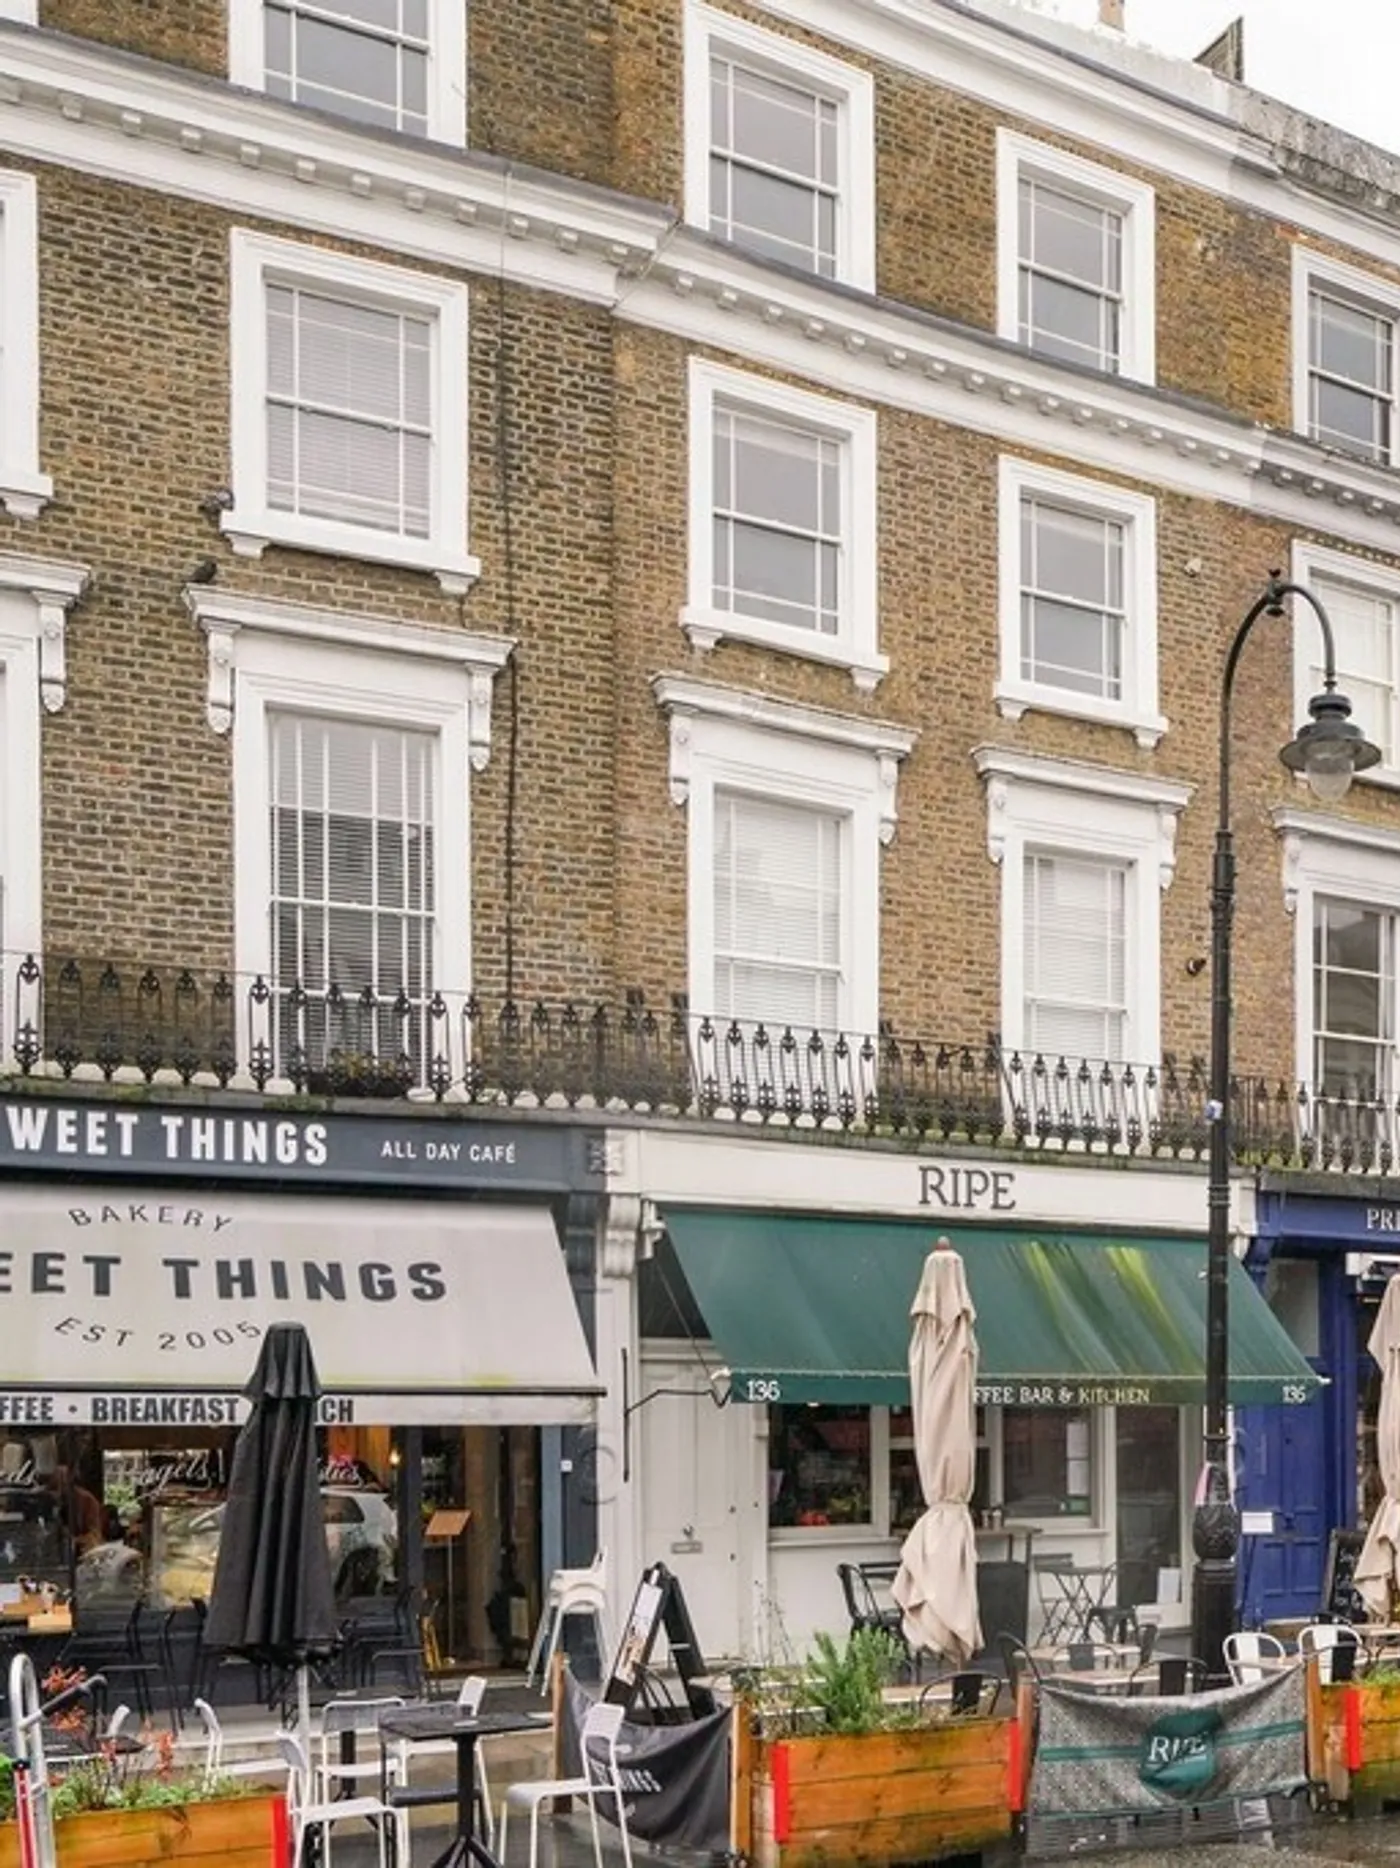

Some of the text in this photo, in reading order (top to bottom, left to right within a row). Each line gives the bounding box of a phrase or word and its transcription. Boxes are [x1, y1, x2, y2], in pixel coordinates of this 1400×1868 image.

[5, 1105, 328, 1167] WEET THINGS
[381, 1140, 516, 1164] ALL DAY CAFÉ
[918, 1164, 1017, 1211] RIPE
[67, 1204, 233, 1233] BAKERY
[162, 1256, 447, 1301] THINGS
[54, 1315, 262, 1350] EST 2005
[745, 1378, 781, 1402] 136
[1019, 1386, 1054, 1405] BAR
[1058, 1386, 1074, 1405] &
[1078, 1386, 1151, 1405] KITCHEN
[91, 1396, 239, 1424] BREAKFAST
